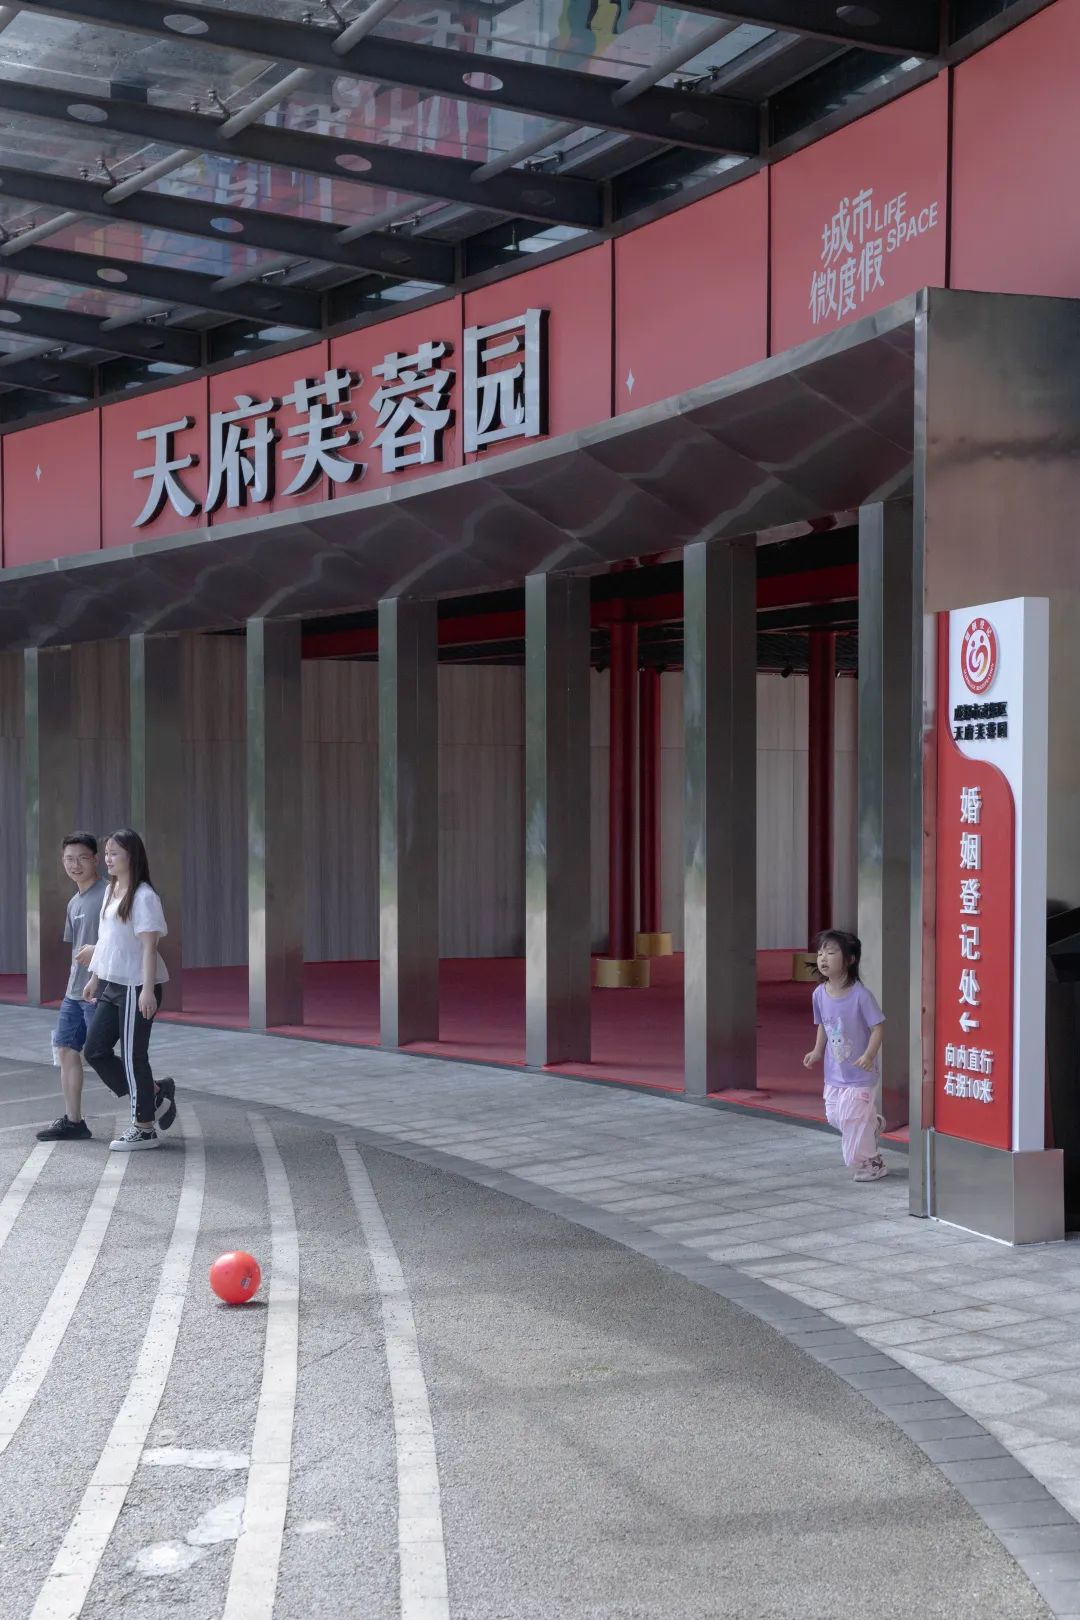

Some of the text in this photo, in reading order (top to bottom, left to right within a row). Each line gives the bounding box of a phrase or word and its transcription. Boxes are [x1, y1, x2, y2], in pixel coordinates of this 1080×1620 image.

[821, 188, 873, 268] 城市
[875, 192, 907, 232] LIFE
[886, 202, 937, 253] SPACE
[808, 238, 884, 325] 微度假
[132, 308, 550, 528] 天府芙蓉园
[953, 721, 1008, 741] 天府芙蓉园
[959, 786, 982, 1006] 婚姻登记处
[944, 1042, 994, 1074] 向内直行
